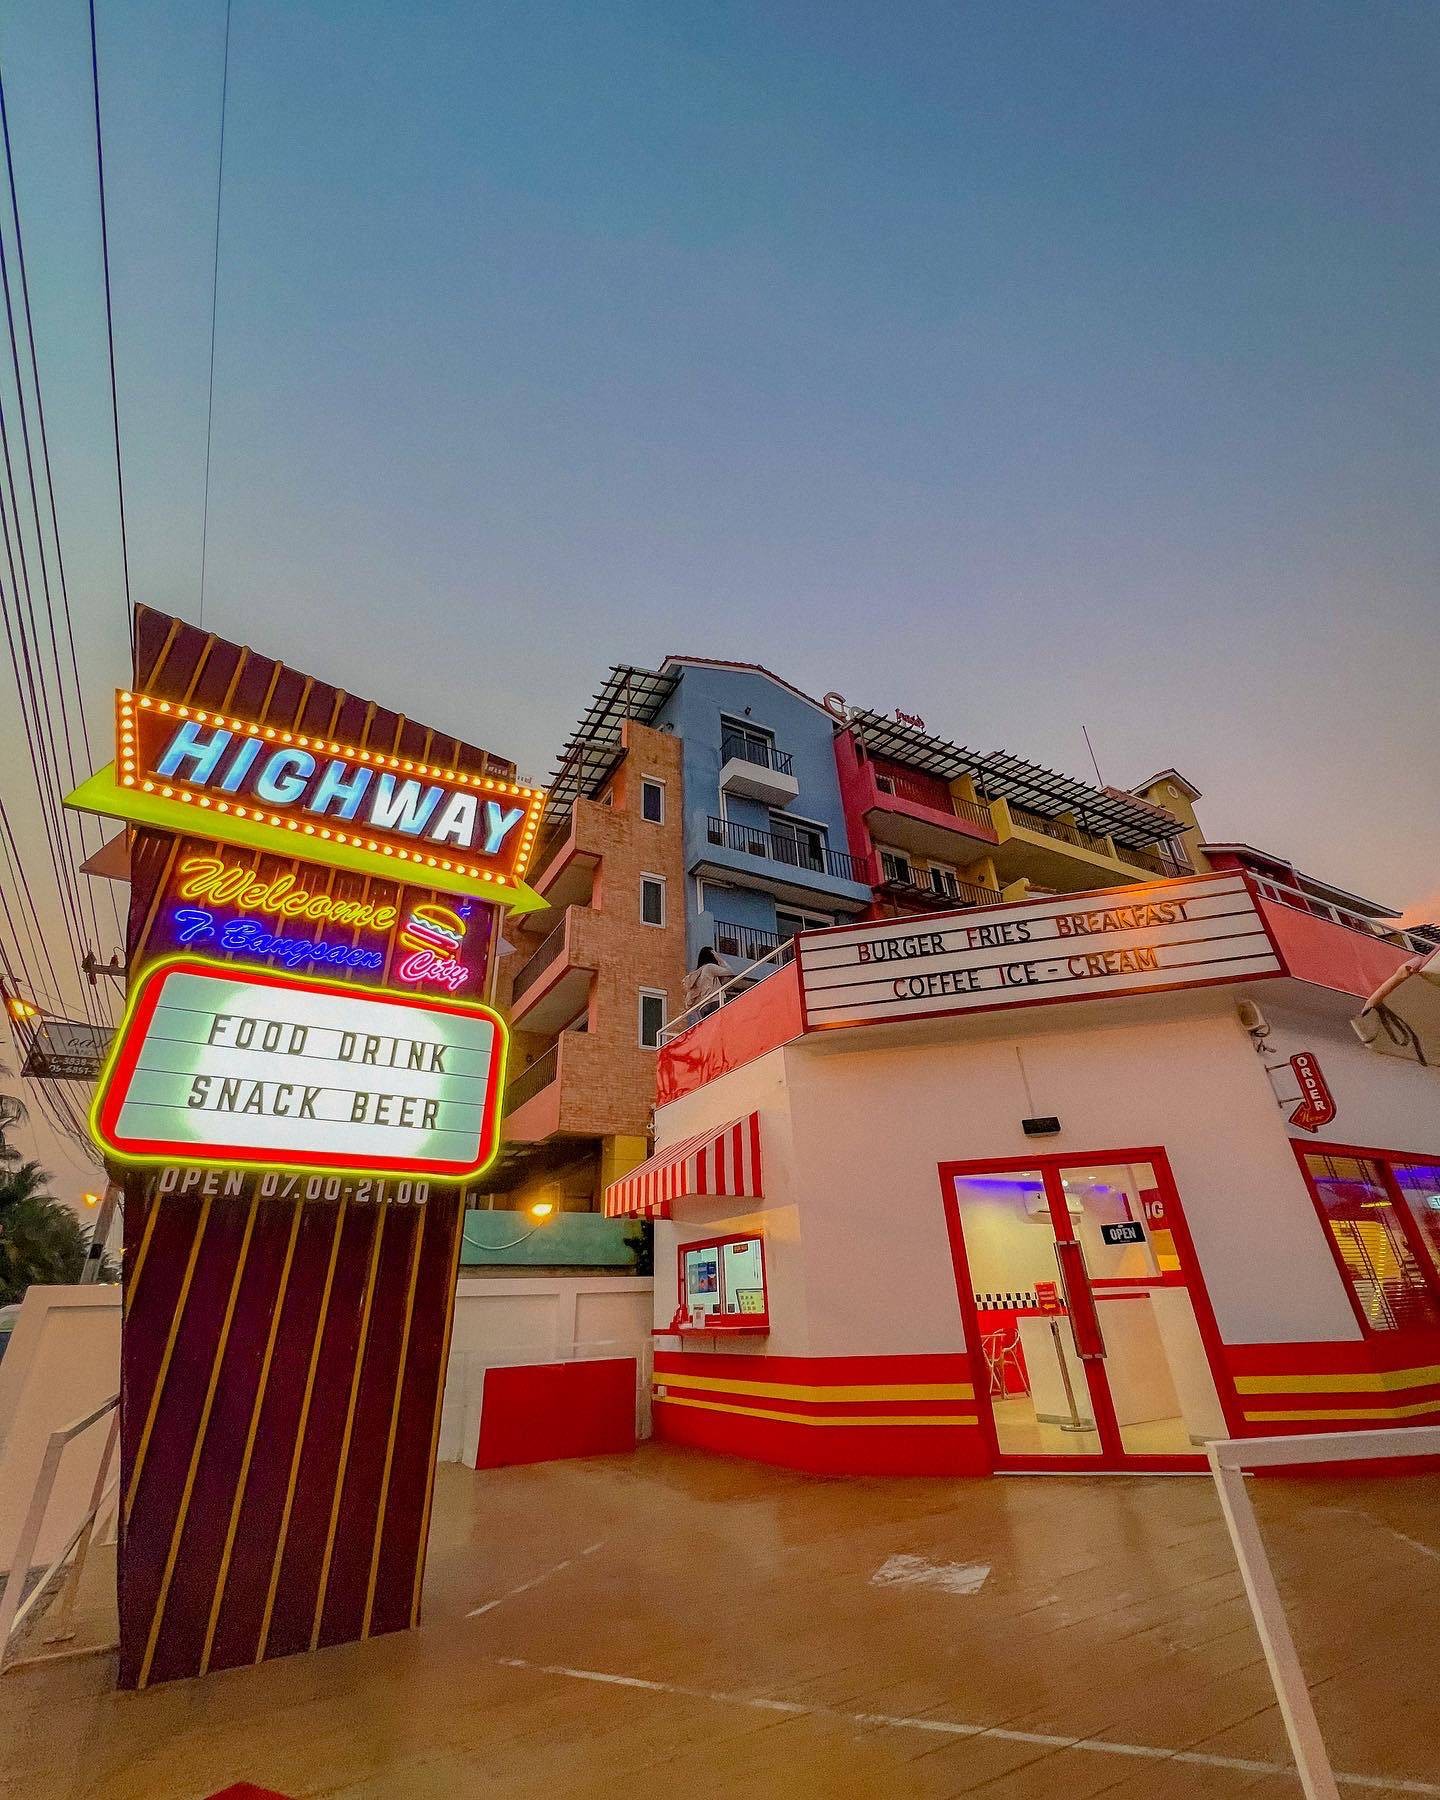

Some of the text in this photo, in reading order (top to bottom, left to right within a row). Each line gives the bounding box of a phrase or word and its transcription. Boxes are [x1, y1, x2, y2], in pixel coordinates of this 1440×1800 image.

[154, 720, 526, 856] HIGHWAY
[180, 857, 398, 931] Welcome
[220, 917, 384, 969] Bangsaen
[857, 900, 1191, 963] BURGER FRIES BREAKFAST
[399, 948, 471, 991] City
[893, 969, 981, 1000] COFFEE
[999, 961, 1040, 987] ICE
[1067, 946, 1160, 980] CREAM
[207, 1013, 450, 1073] FOOD DRINK
[187, 1074, 441, 1130] SNACK BEER
[1297, 1057, 1327, 1111] ORDER
[159, 1166, 430, 1205] OPEN 07.00-21.00
[1109, 1226, 1137, 1242] OPEN
